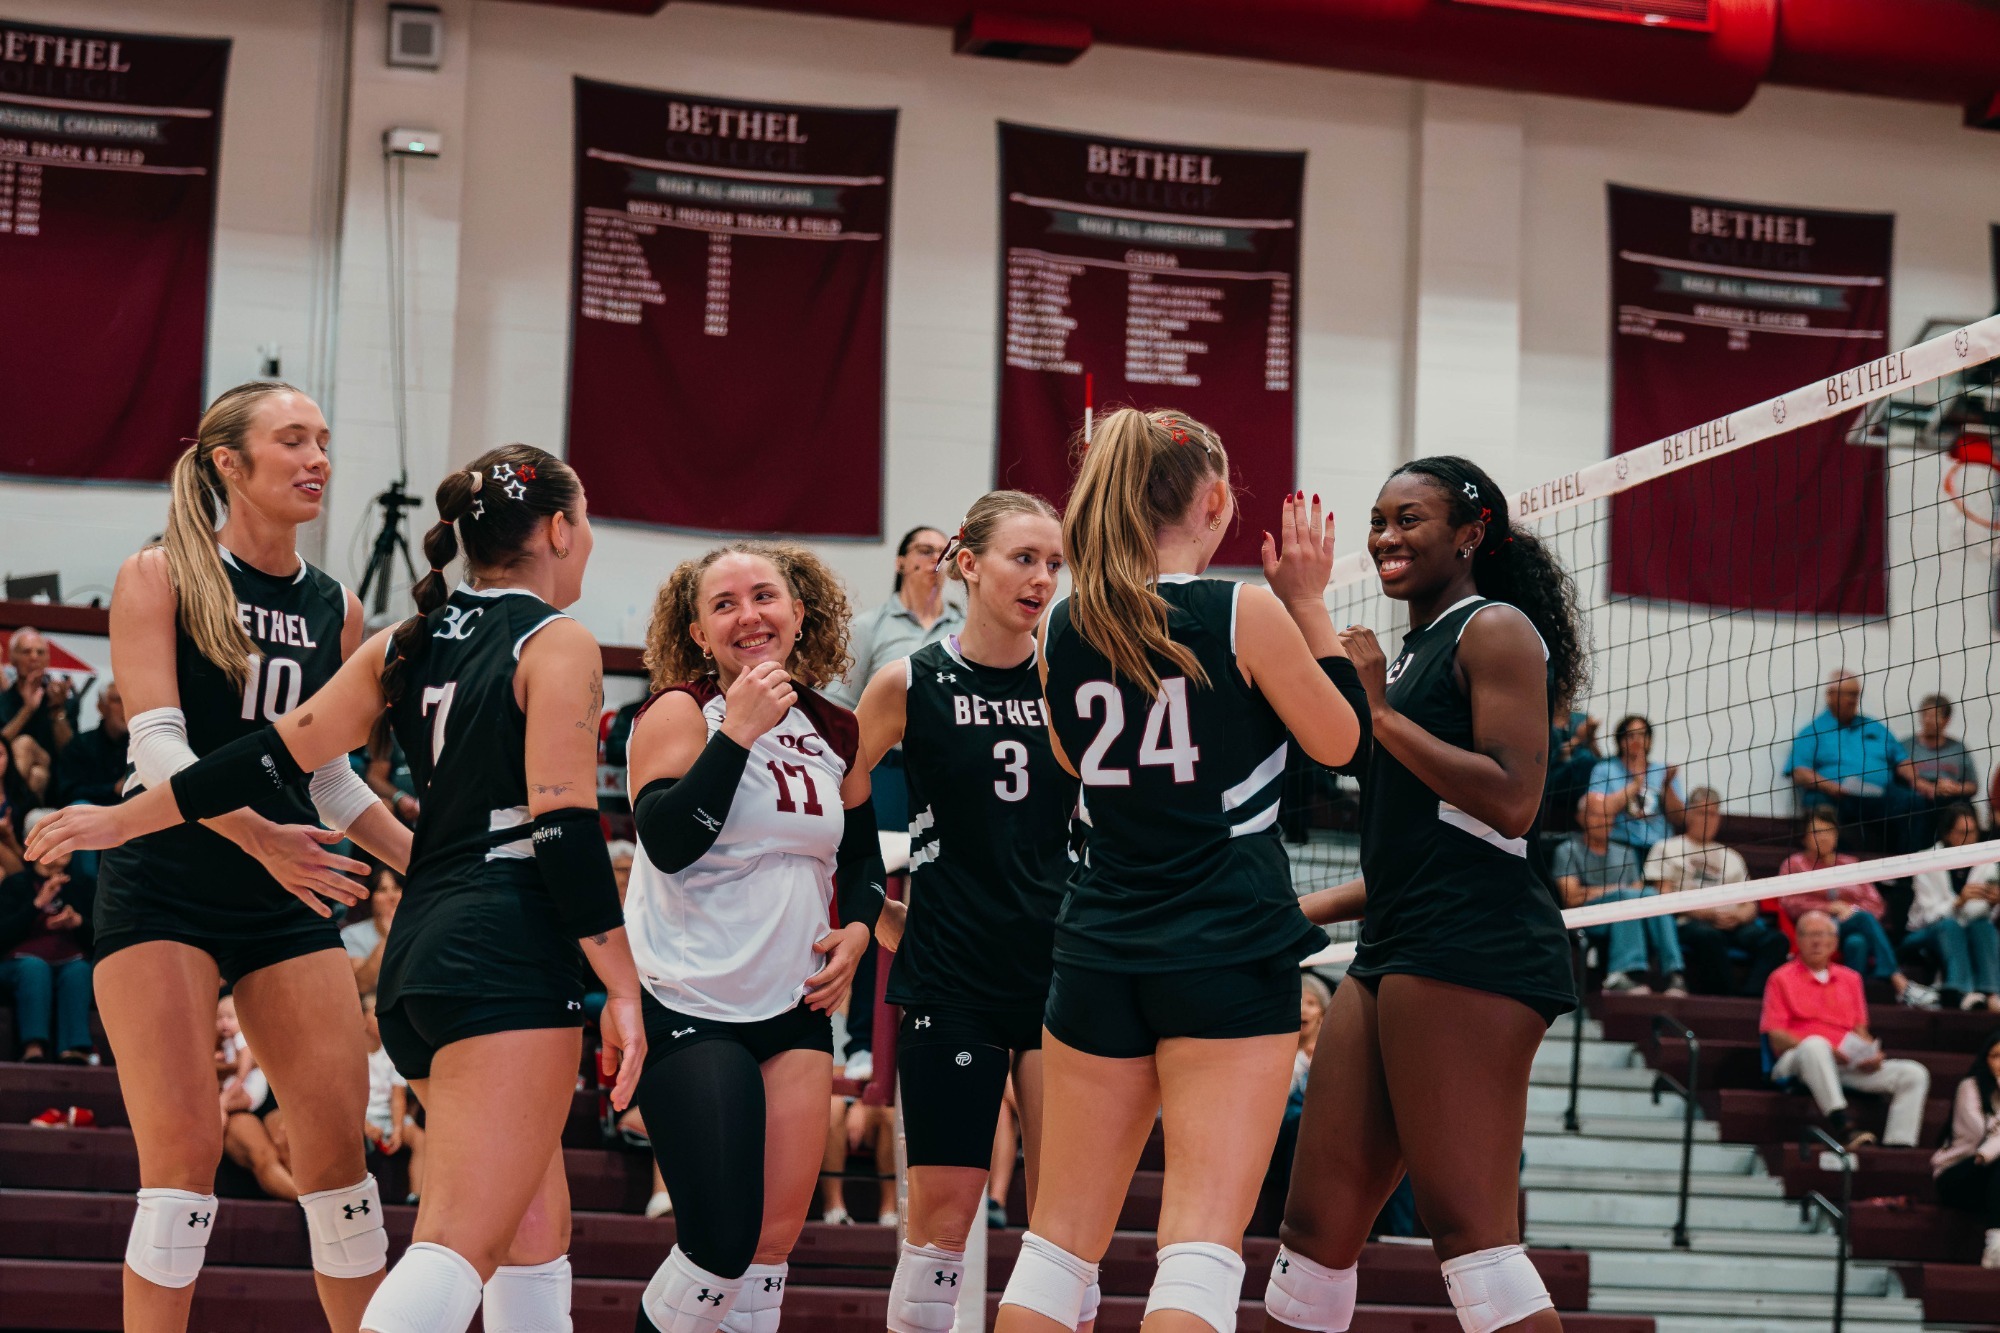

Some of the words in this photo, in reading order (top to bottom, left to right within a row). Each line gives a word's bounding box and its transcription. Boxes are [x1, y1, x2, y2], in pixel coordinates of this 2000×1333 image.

[0, 31, 131, 73] ETHEL
[667, 102, 808, 144] BETHEL
[1087, 144, 1222, 186] BETHEL
[1690, 205, 1816, 246] BETHEL
[1826, 351, 1912, 406] BETHEL
[1662, 416, 1736, 465] BETHEL
[1519, 471, 1585, 516] BETHEL
[237, 602, 317, 648] ETHEL
[241, 653, 302, 723] 10
[421, 682, 457, 788] 7
[1075, 677, 1199, 786] 24
[766, 760, 824, 816] 17
[993, 740, 1030, 801] 3
